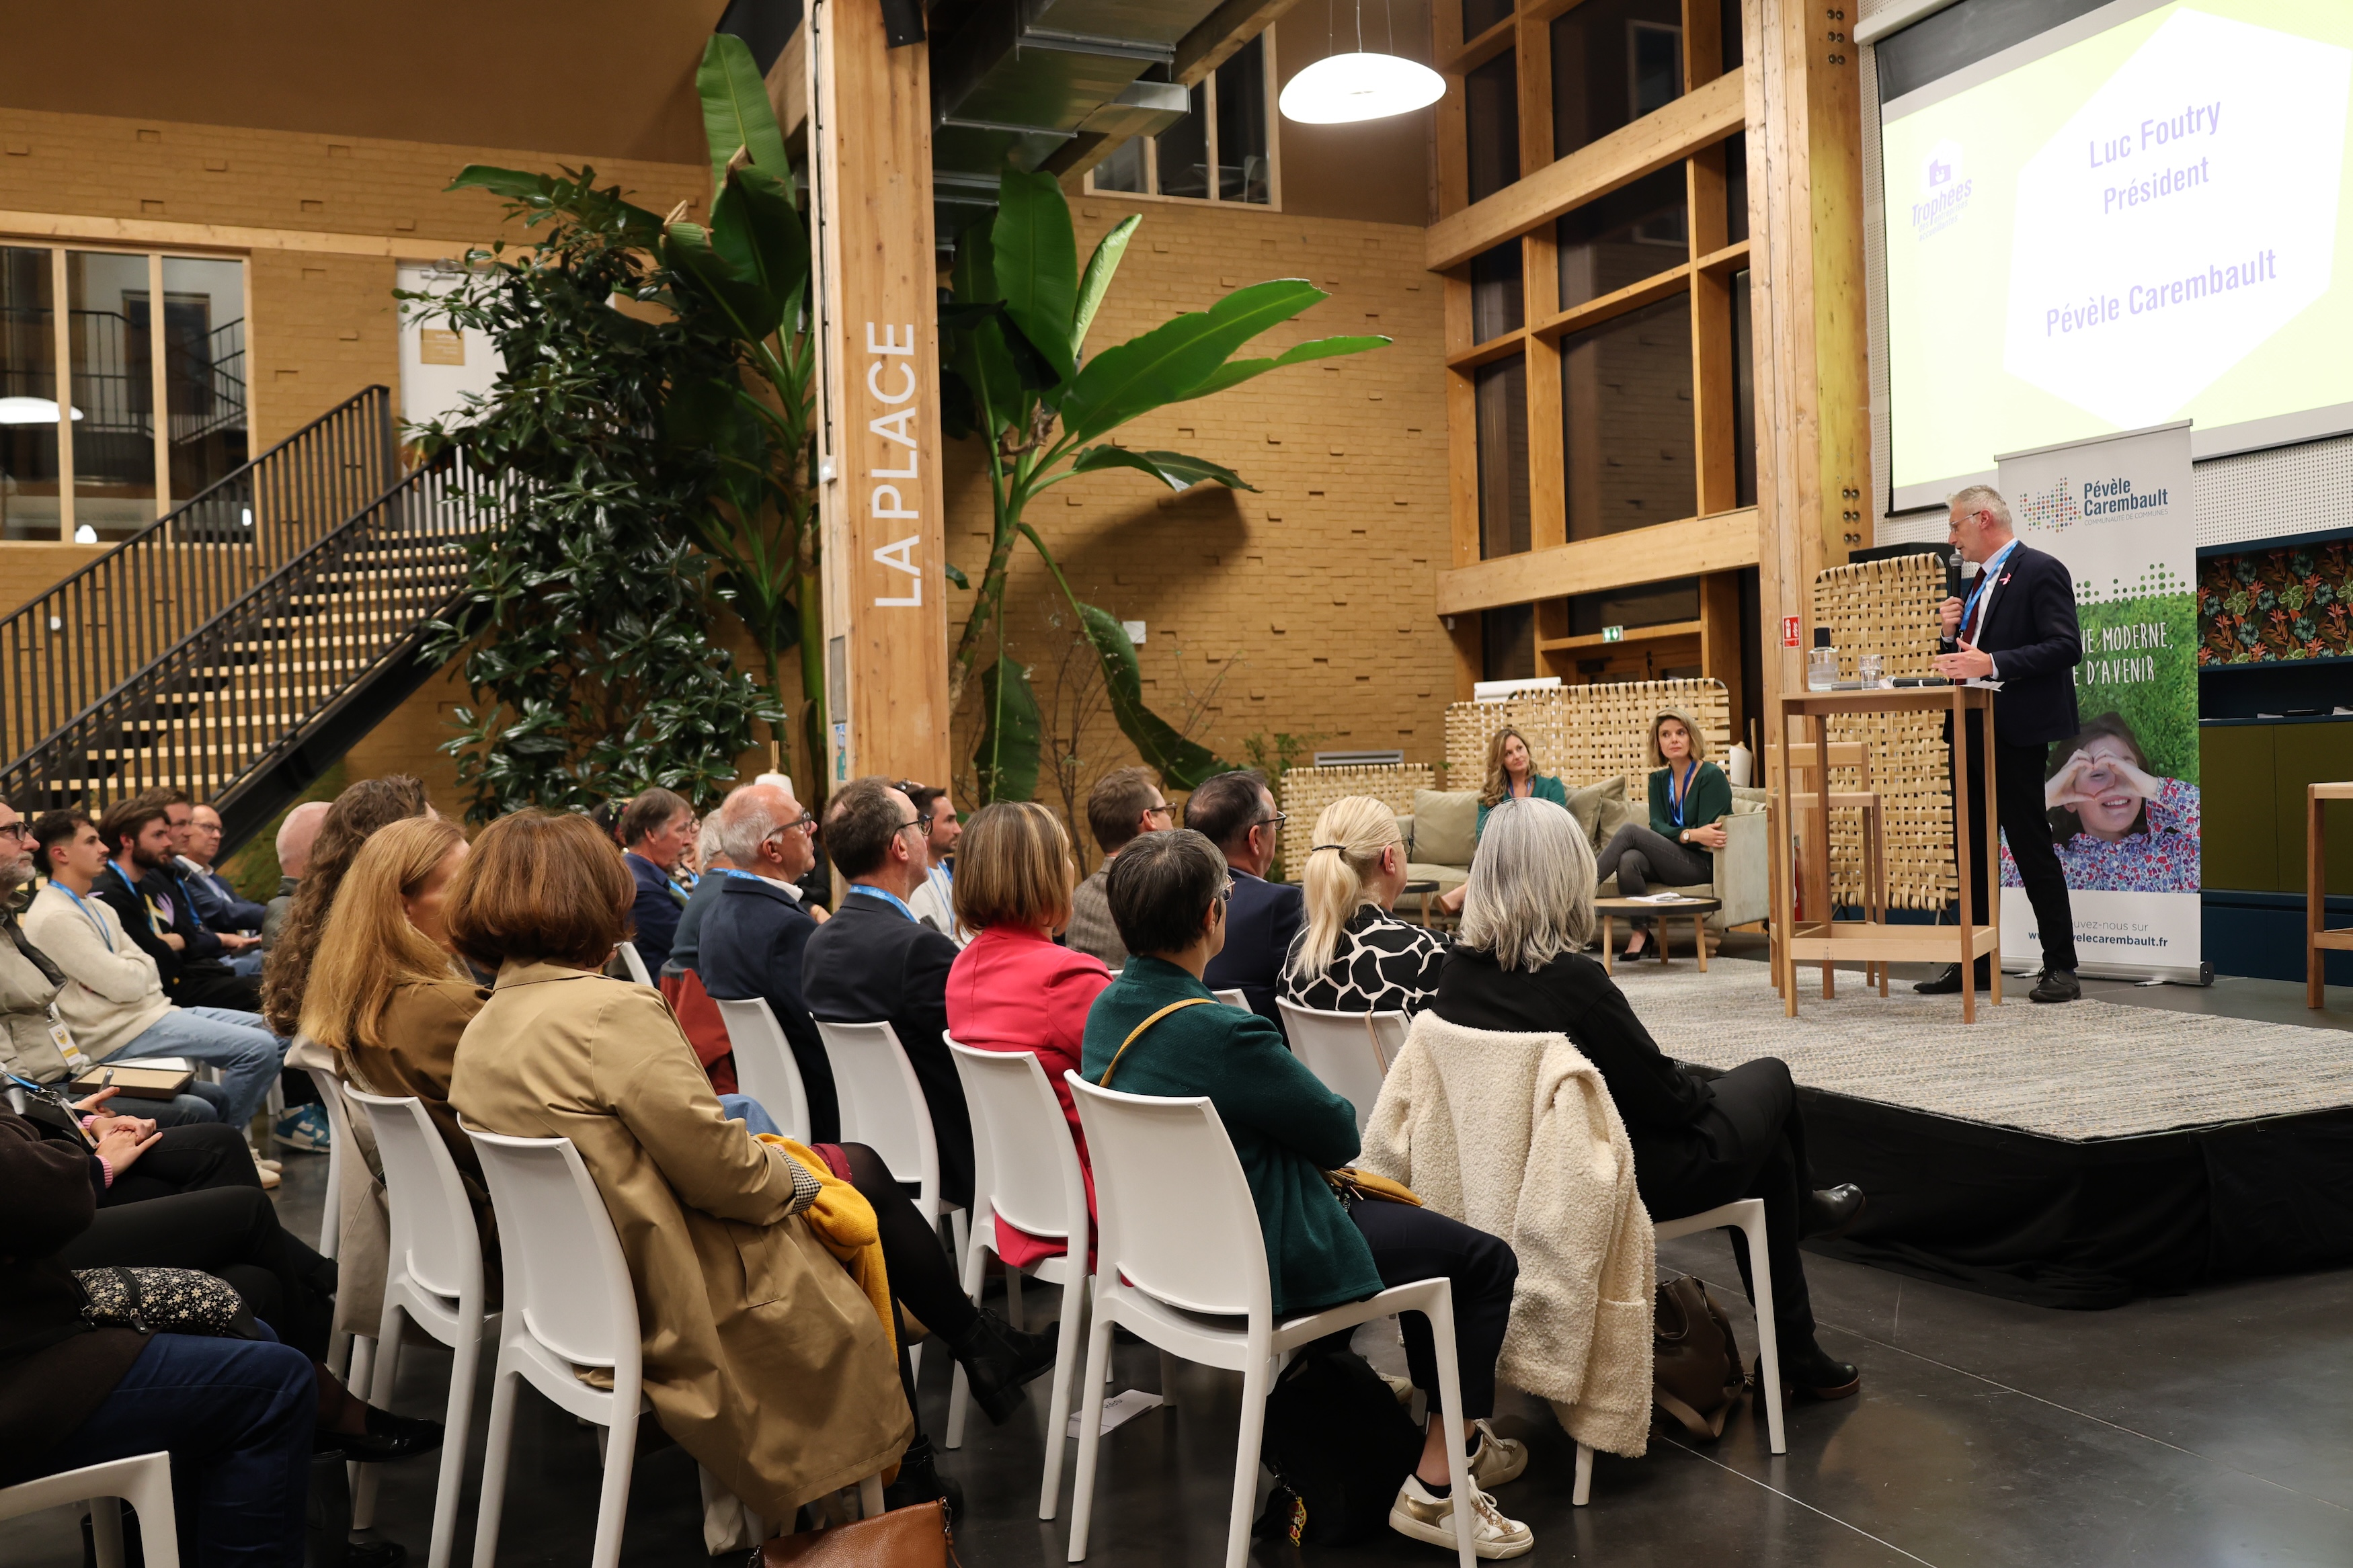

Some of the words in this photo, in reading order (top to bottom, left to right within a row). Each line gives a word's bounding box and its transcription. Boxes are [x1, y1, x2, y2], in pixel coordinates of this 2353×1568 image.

[2090, 135, 2130, 168] Luc
[2141, 101, 2220, 151] Foutry
[1912, 178, 1972, 226] Trophées
[2104, 157, 2209, 214] Président
[2047, 295, 2119, 337] Pévèle
[2130, 249, 2276, 315] Carembault
[867, 322, 920, 519] PLACE
[2084, 477, 2130, 499] Pévèle
[2084, 489, 2168, 516] Carembault
[2135, 509, 2168, 519] COMMUNES
[874, 535, 922, 606] LA
[2103, 622, 2173, 651] MODERNE,
[2074, 921, 2128, 931] uvez-nous
[2132, 923, 2149, 932] sur
